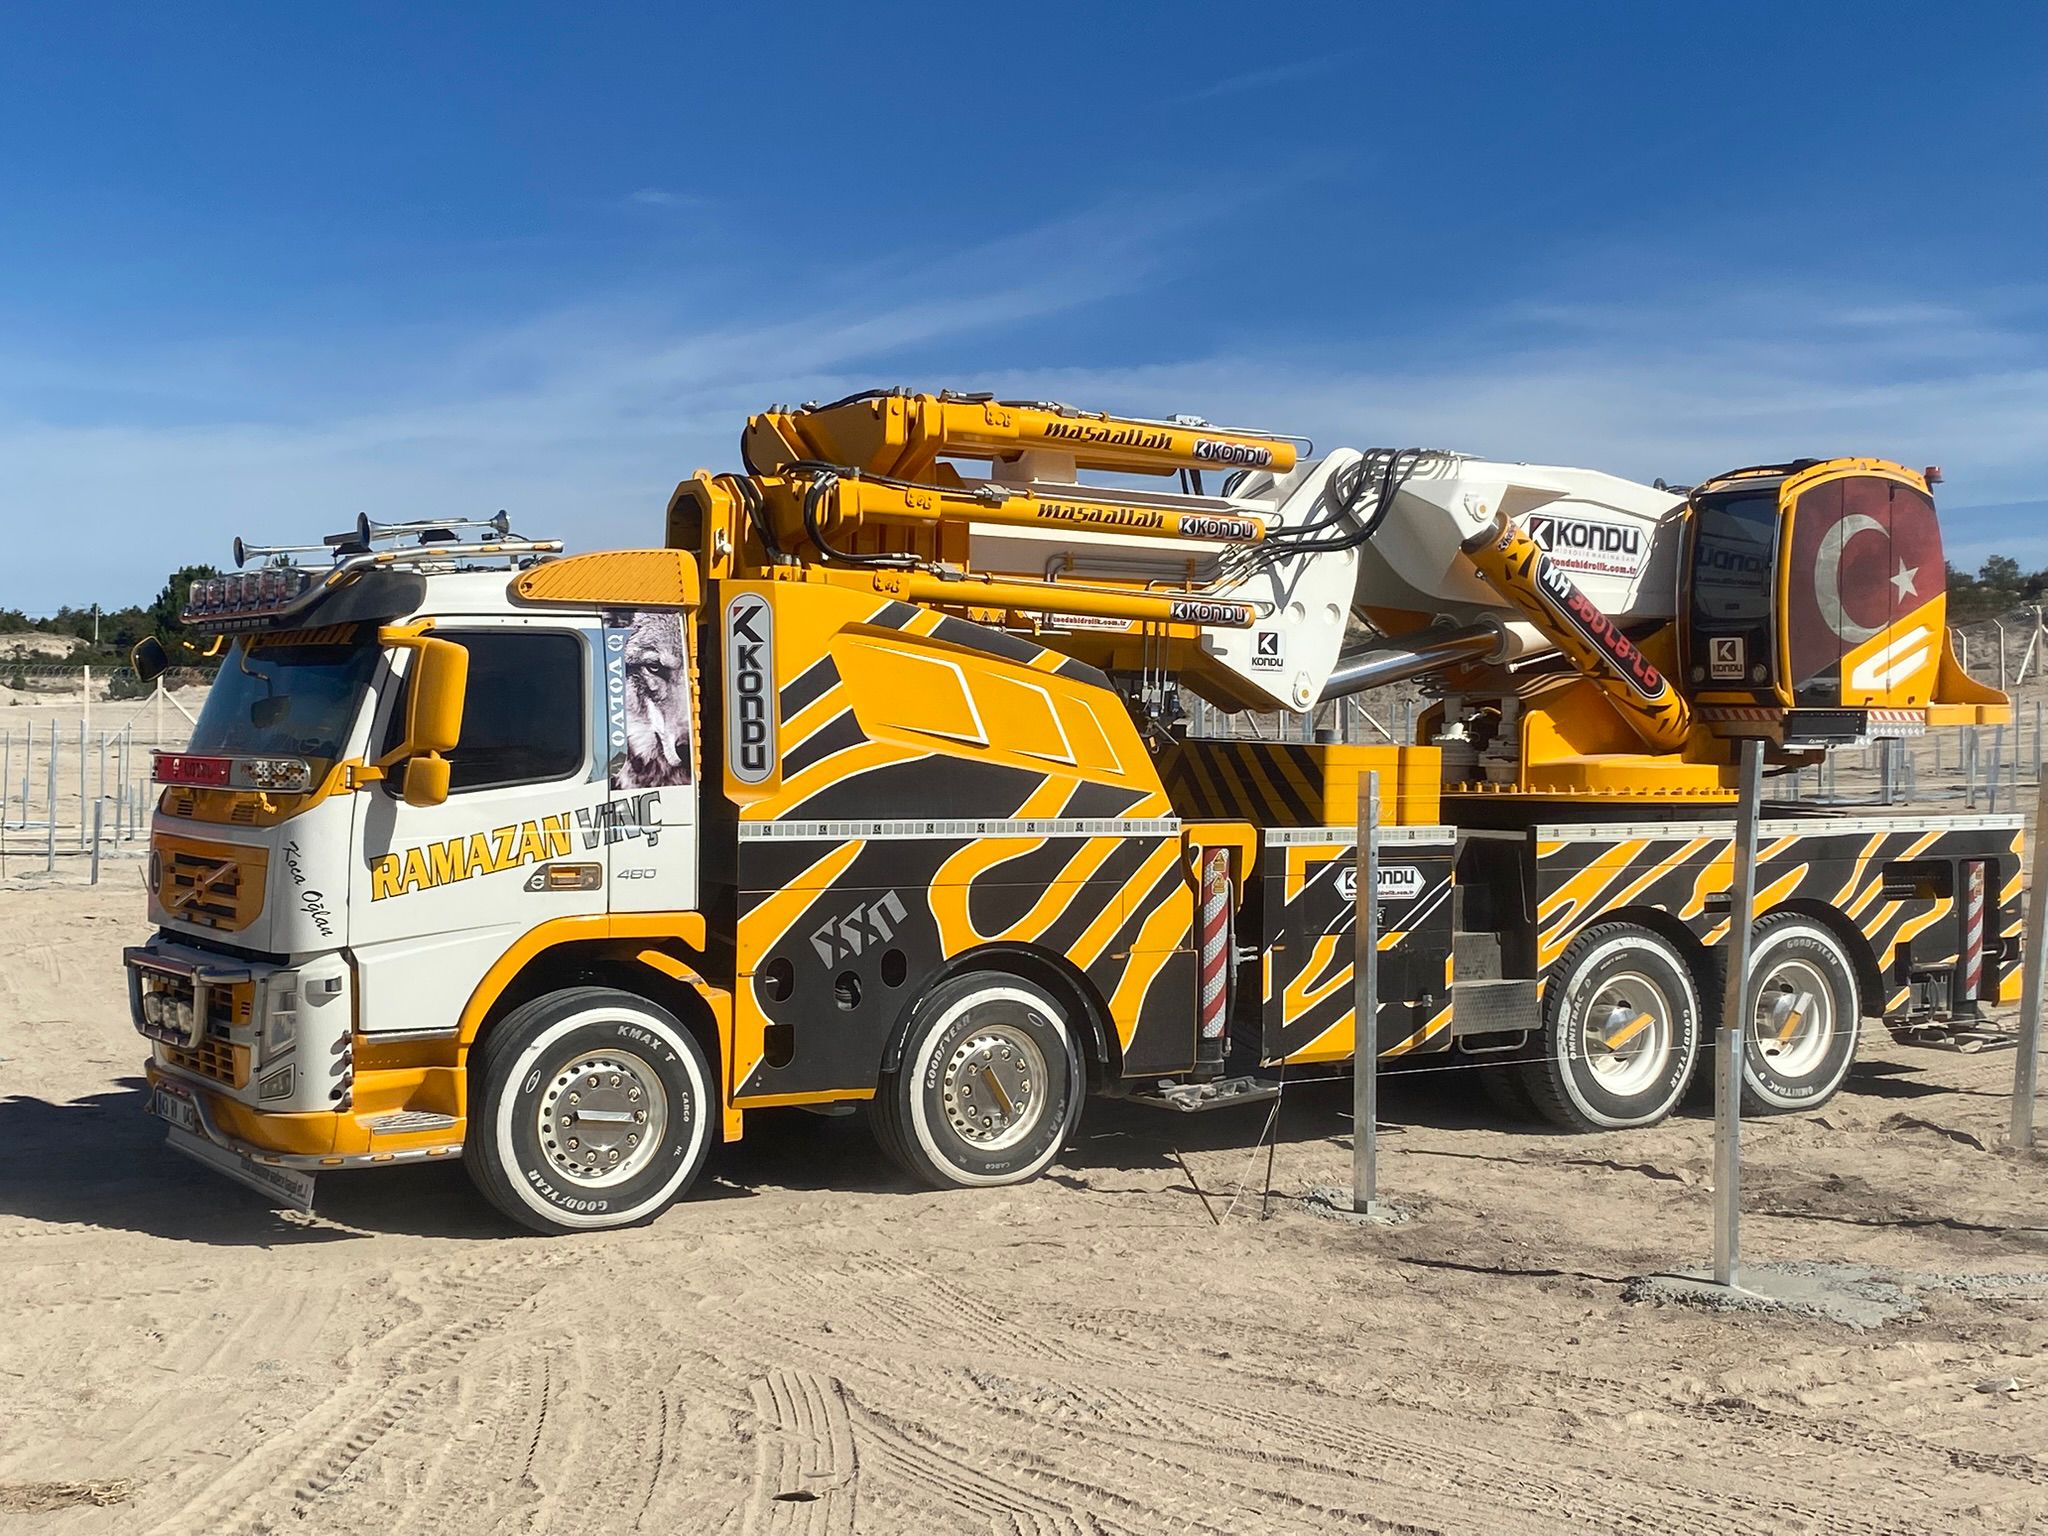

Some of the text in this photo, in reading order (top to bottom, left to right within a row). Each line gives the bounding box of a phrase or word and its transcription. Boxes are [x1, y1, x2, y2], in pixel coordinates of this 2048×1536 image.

[1556, 520, 1639, 555] KONDU
[1542, 568, 1573, 599] KH
[1251, 657, 1284, 667] KONDU
[608, 656, 626, 747] VOLVO
[737, 644, 767, 771] KONDU
[282, 840, 306, 886] Koca
[369, 811, 571, 902] RAMAZAN
[616, 1024, 678, 1063] KMAX T
[1569, 994, 1586, 1061] OMNITRAC
[1669, 1008, 1693, 1090] GOODYEAR
[926, 1013, 973, 1090] GOODYEAR
[680, 1091, 691, 1123] CARGO
[527, 1168, 609, 1213] GOODYEAR
